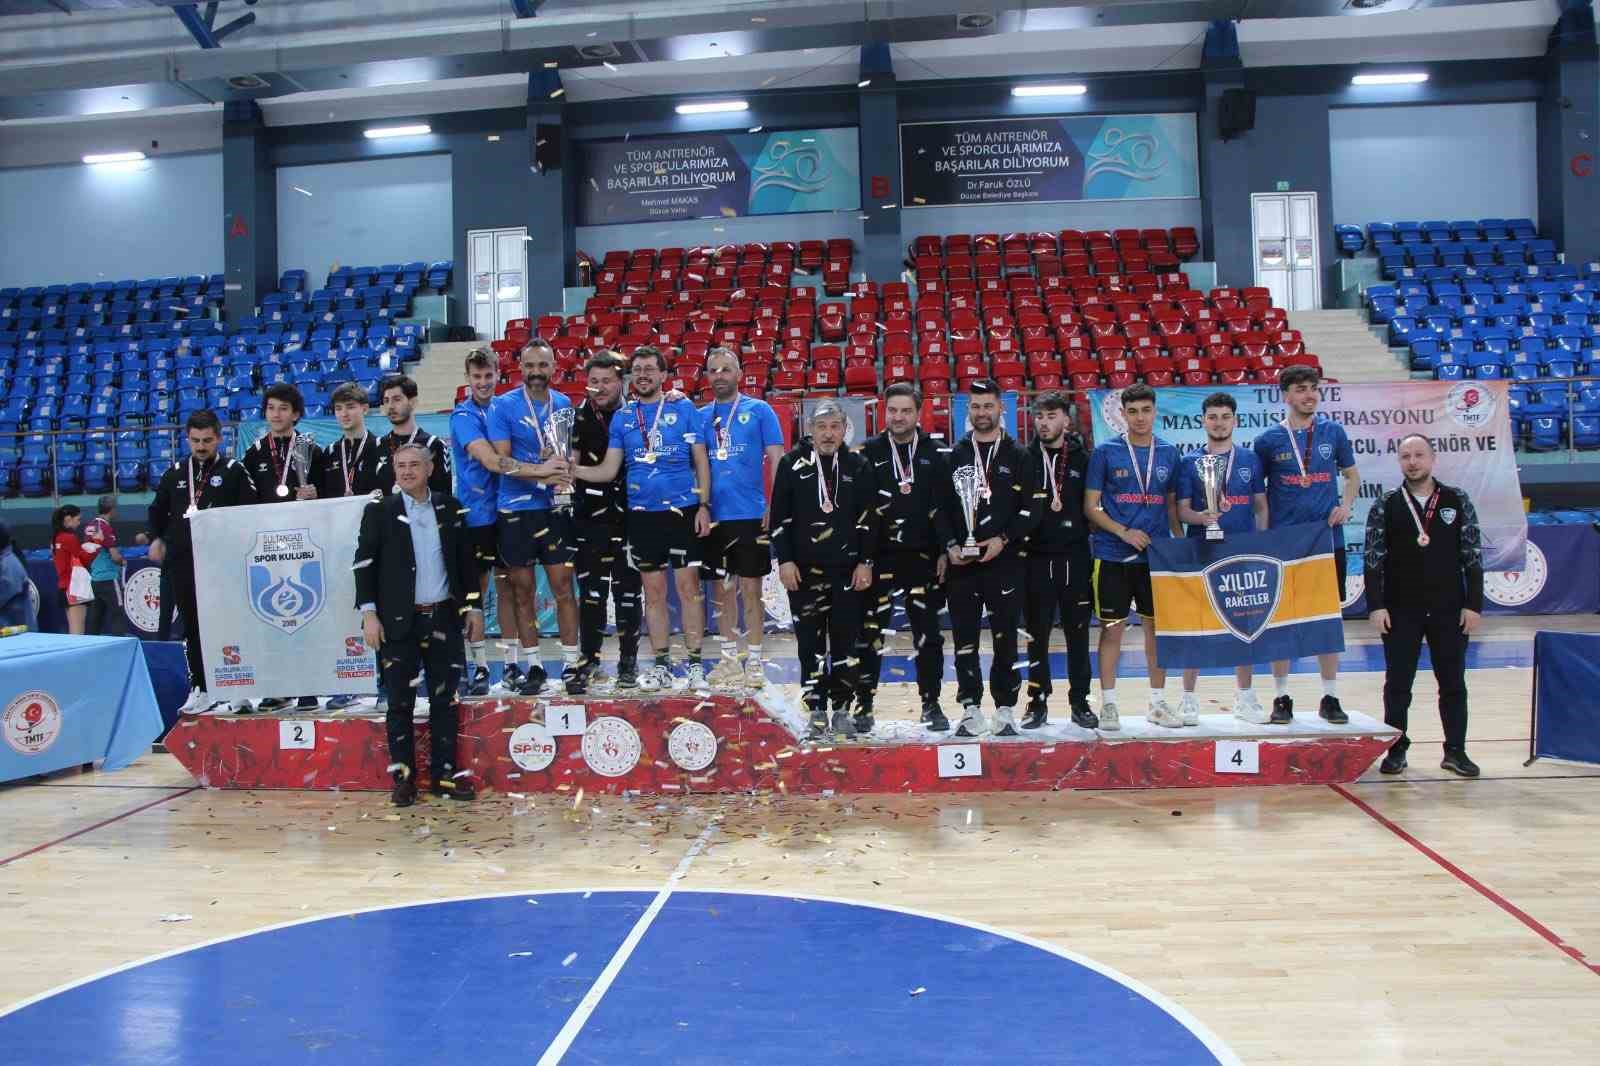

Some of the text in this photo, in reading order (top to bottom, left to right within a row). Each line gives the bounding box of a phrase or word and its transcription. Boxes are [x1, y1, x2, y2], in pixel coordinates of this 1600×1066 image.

[955, 129, 1048, 144] TÜM ANTRENÖR
[626, 145, 715, 161] TÜM ANTRENÖR
[942, 142, 1062, 156] VE SPORCULARIMIZA
[614, 157, 729, 175] VE SPORCULARIMIZA
[935, 156, 1070, 173] BAŞARILAR DİLİYORUM
[607, 171, 736, 190] BAŞARILAR DİLİYORUM
[1006, 178, 1031, 189] ÖZLÜ
[1162, 414, 1204, 430] MAS
[1476, 435, 1497, 451] VE
[254, 554, 277, 563] SPOR
[1220, 570, 1268, 591] YILDIZ
[1225, 592, 1270, 608] RAKETLER
[561, 713, 569, 729] 1
[25, 733, 44, 745] TMTF
[294, 726, 304, 741] 2
[513, 743, 553, 753] SPOR
[954, 752, 966, 770] 3
[1231, 749, 1243, 766] 4
